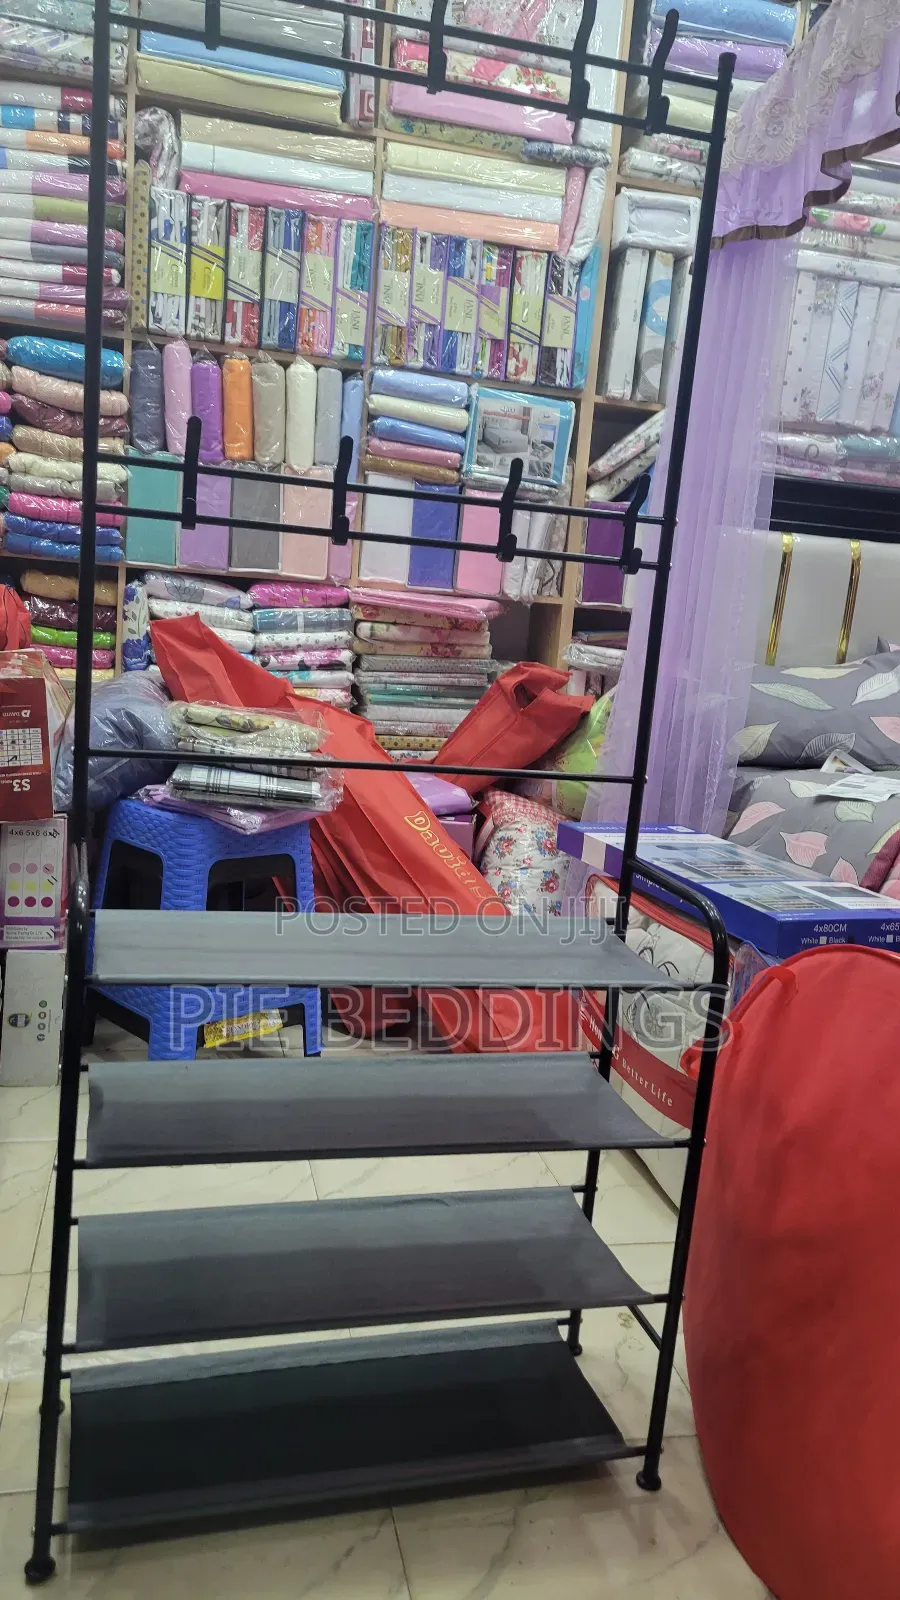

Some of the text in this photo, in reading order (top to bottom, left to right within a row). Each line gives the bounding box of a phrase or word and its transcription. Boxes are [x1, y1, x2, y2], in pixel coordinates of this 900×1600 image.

[12, 778, 31, 792] S3
[9, 828, 24, 837] 4x6
[26, 829, 41, 837] 5x6
[813, 923, 848, 933] 4x80CM
[801, 936, 846, 945] White Black
[622, 1058, 673, 1107] Better Life
